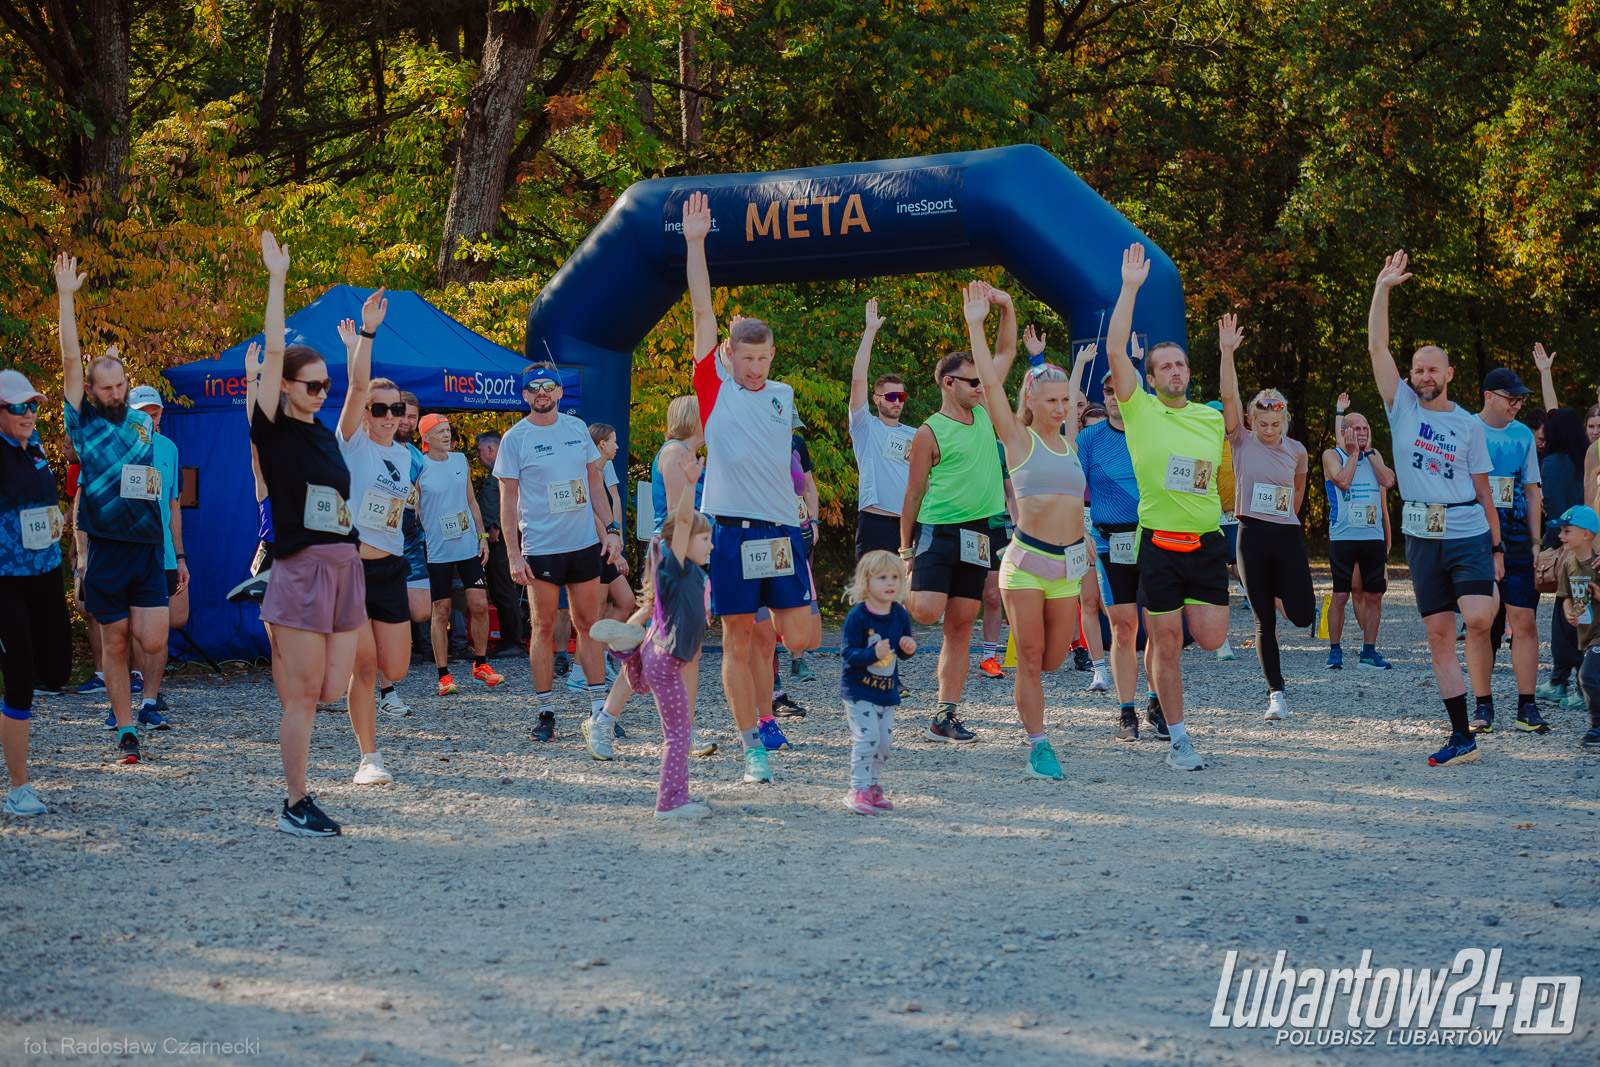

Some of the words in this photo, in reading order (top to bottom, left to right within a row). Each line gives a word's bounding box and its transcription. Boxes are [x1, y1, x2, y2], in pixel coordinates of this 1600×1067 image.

[896, 197, 954, 214] inesSport
[745, 194, 872, 242] META
[204, 373, 248, 399] ines
[443, 368, 516, 400] inesSport
[1419, 422, 1433, 440] 10
[1173, 466, 1191, 478] 243
[130, 476, 141, 484] 92
[554, 490, 570, 499] 152
[1258, 493, 1272, 502] 134
[317, 500, 331, 512] 98
[368, 502, 385, 514] 122
[1408, 512, 1422, 522] 111
[29, 521, 47, 532] 184
[1115, 543, 1131, 551] 170
[749, 551, 768, 562] 167
